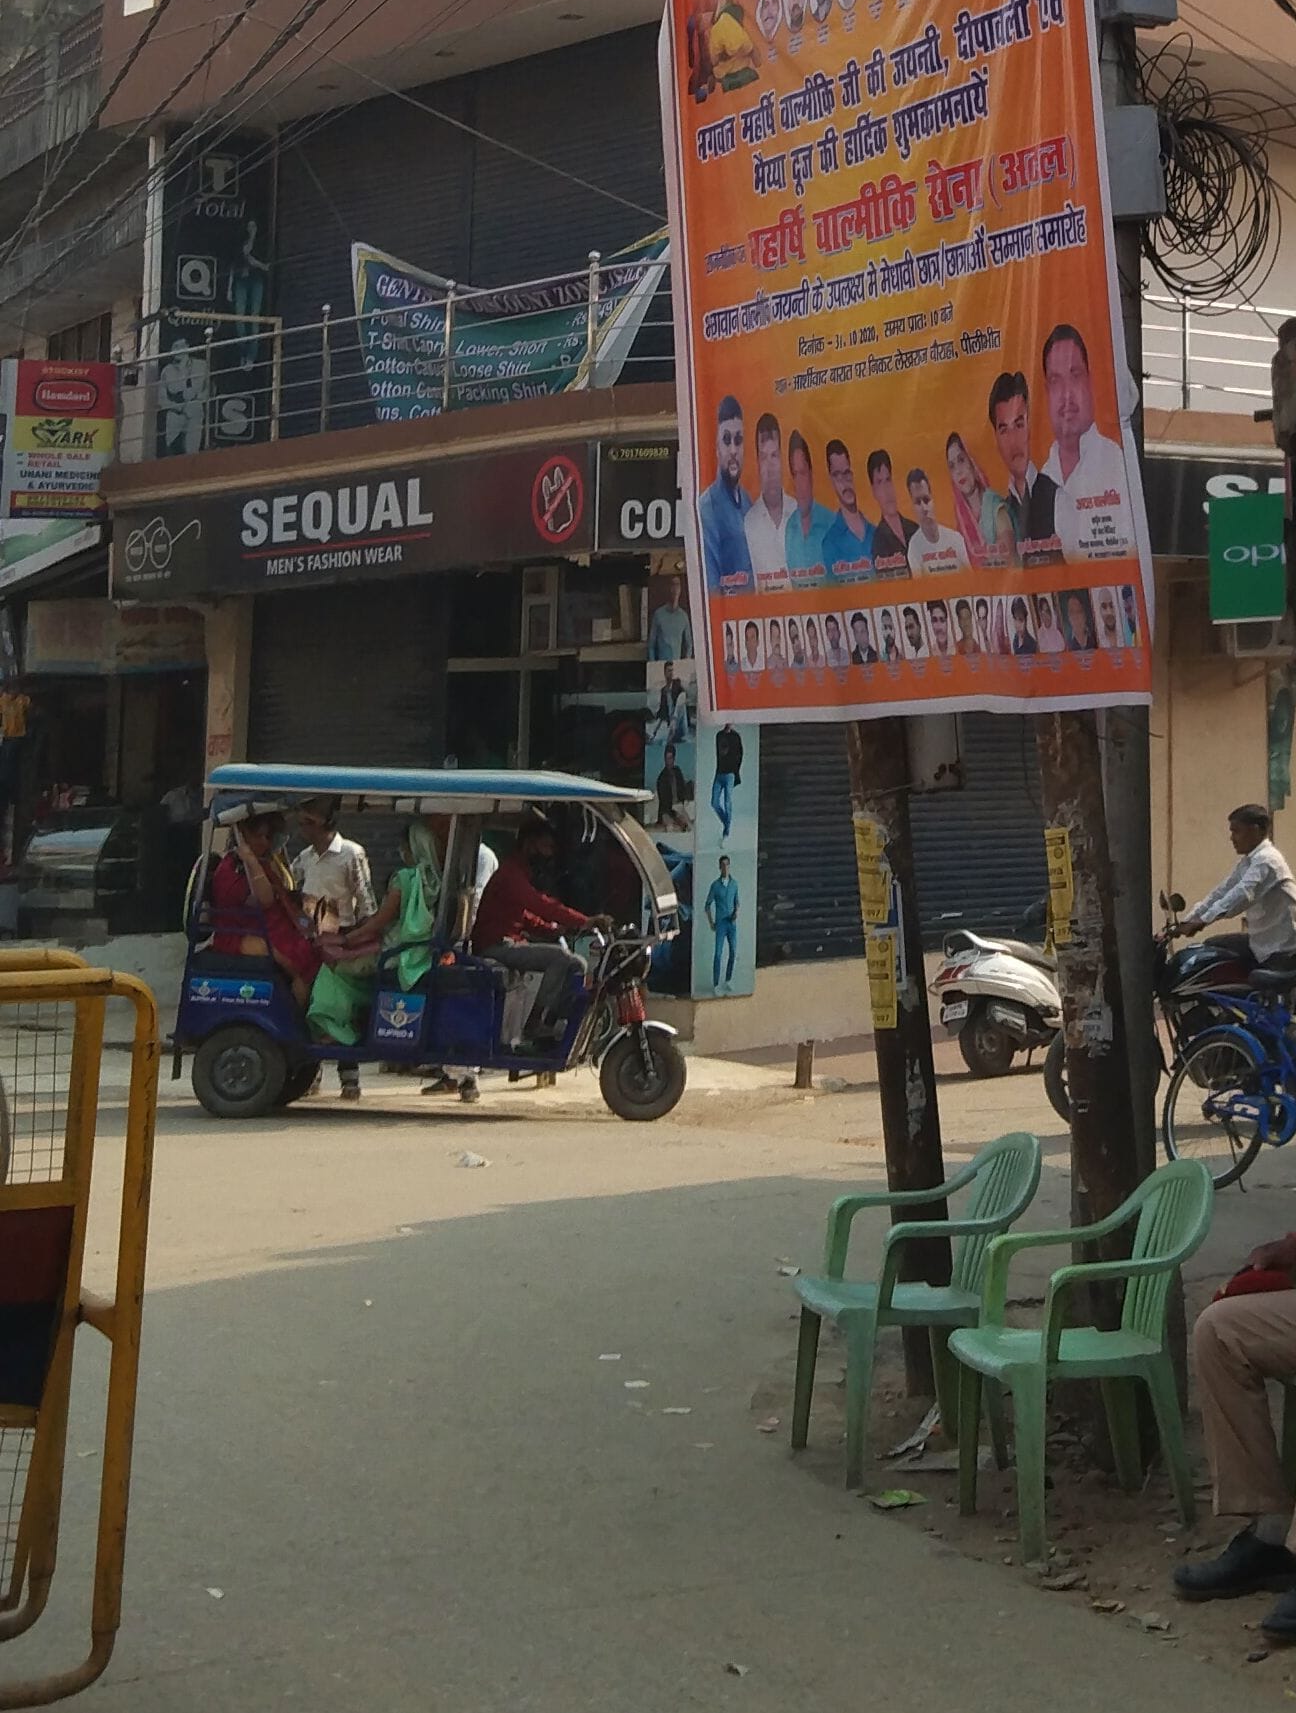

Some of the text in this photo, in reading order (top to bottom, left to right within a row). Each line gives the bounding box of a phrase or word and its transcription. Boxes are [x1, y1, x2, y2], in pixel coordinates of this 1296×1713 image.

[839, 59, 861, 108] जी
[864, 47, 887, 97] की
[816, 126, 839, 175] की
[842, 111, 888, 167] हार्दिक
[205, 159, 232, 190] T
[194, 197, 247, 219] Total
[812, 172, 918, 255] वाल्मीकि
[924, 159, 984, 223] सेना
[181, 259, 212, 296] Q
[772, 278, 810, 321] जयन्ती
[812, 276, 824, 311] के
[880, 253, 914, 296] मेधावी
[988, 224, 1036, 270] सम्मान
[1037, 203, 1088, 254] समारोह
[370, 379, 411, 398] otton
[220, 399, 249, 436] S
[240, 477, 434, 548] SEQUAL
[620, 499, 683, 540] CO
[266, 544, 403, 576] MEN'S FASHION WEAR
